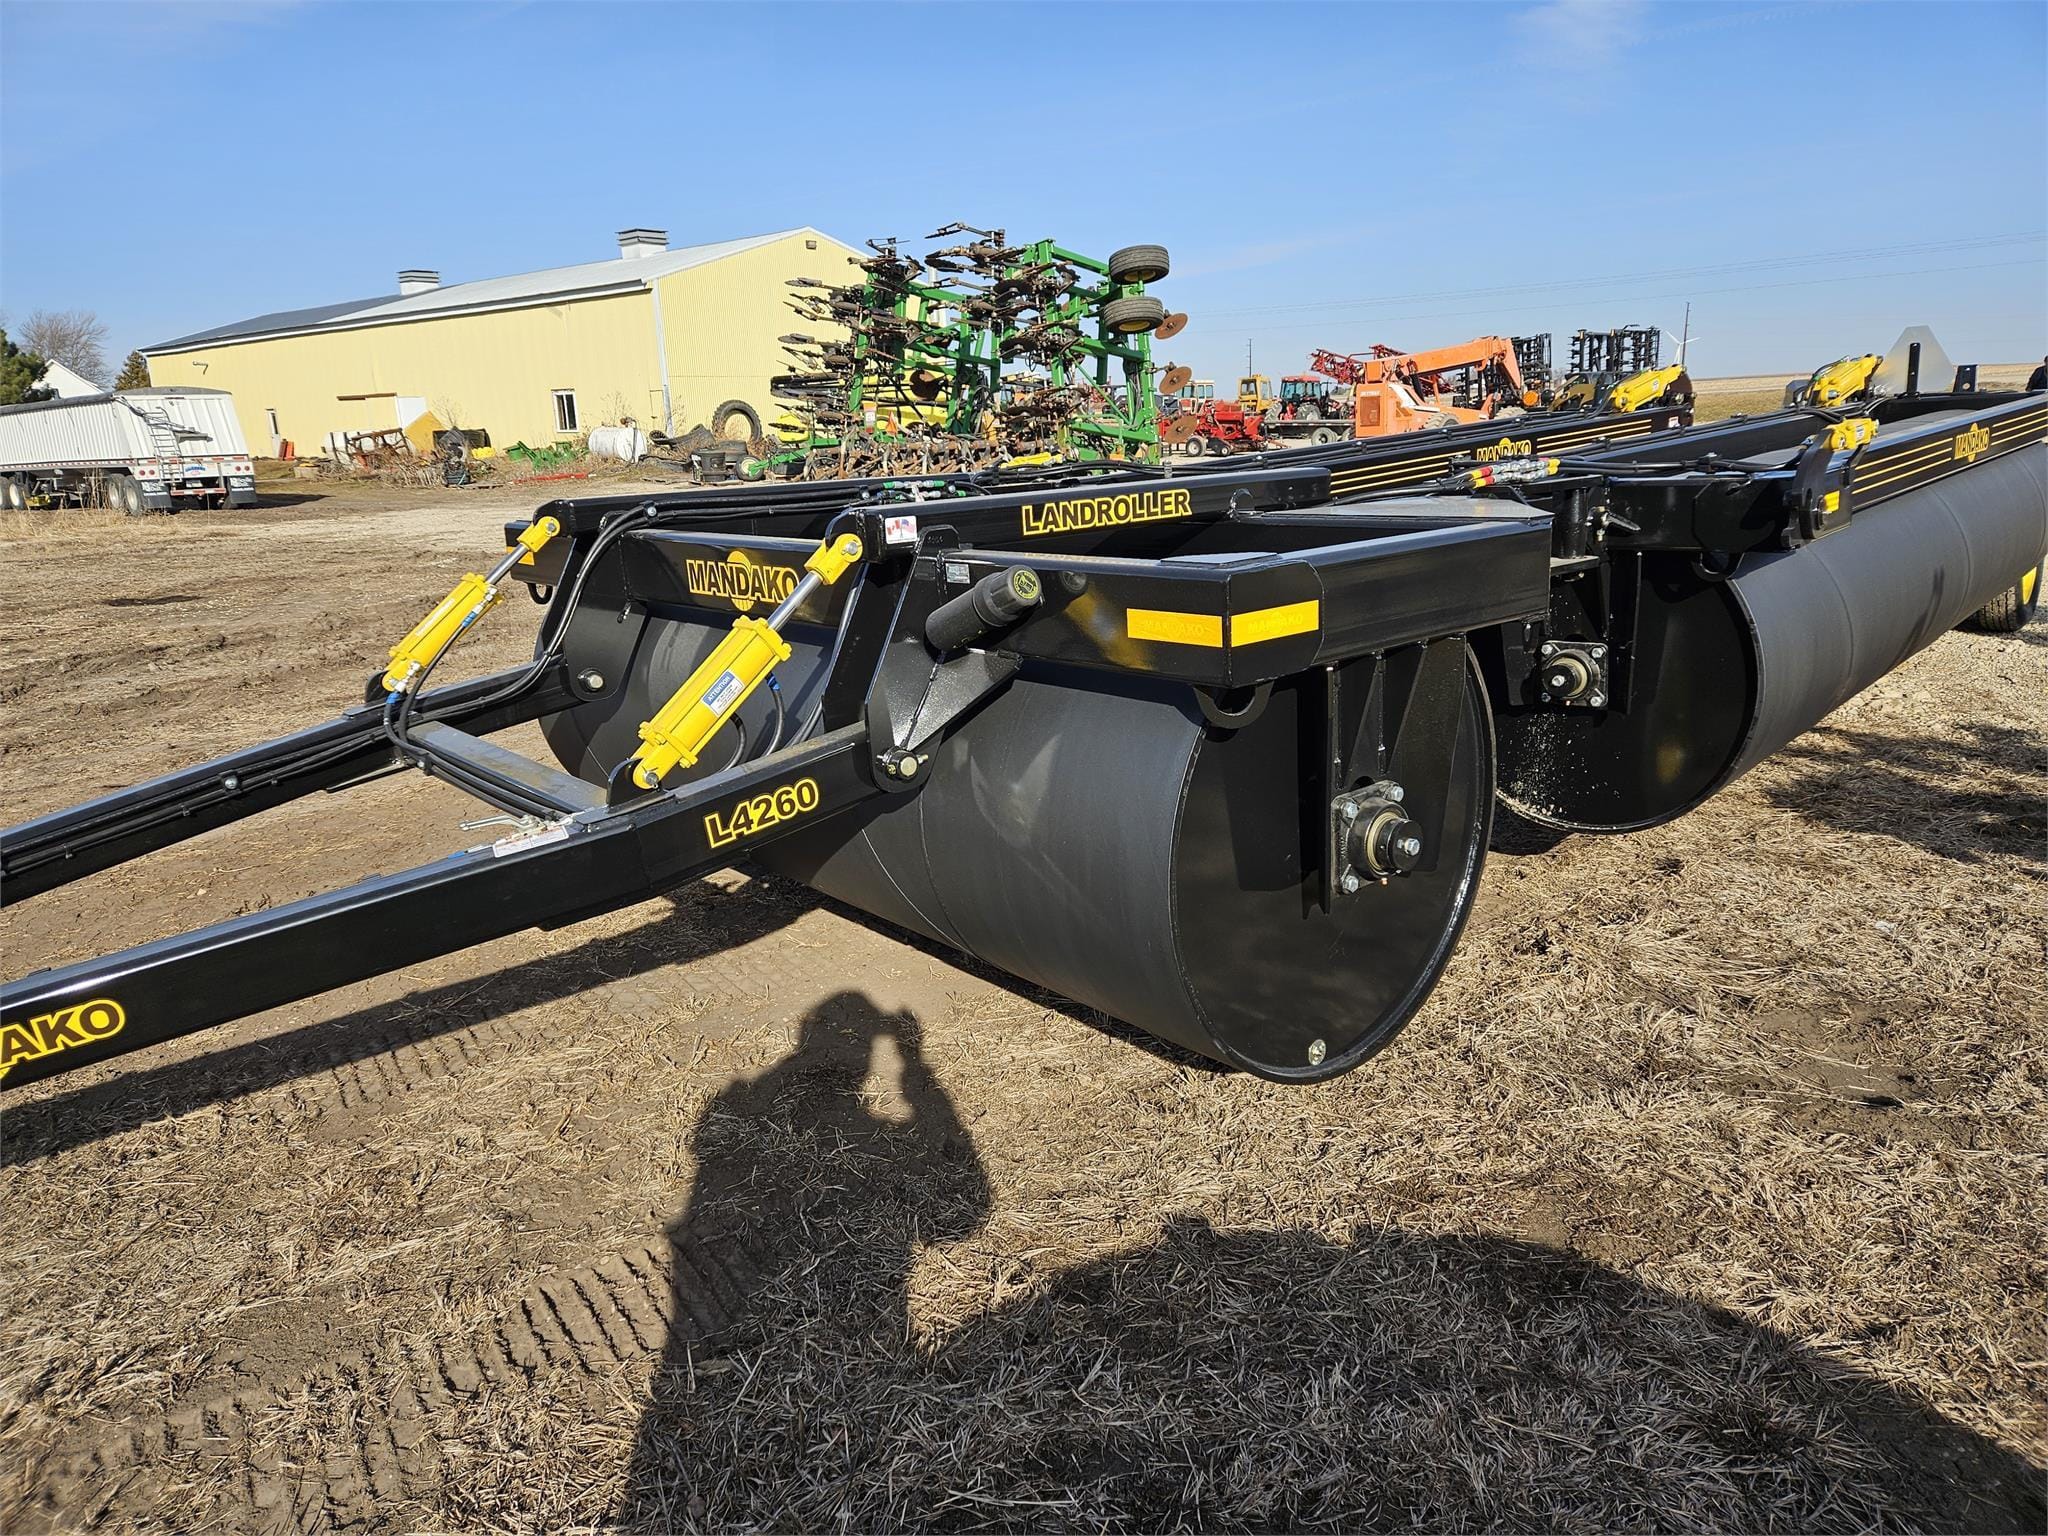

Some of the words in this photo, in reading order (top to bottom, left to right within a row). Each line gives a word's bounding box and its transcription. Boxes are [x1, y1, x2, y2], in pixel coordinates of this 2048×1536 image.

[1476, 439, 1532, 462] MANDAKO
[1954, 427, 1990, 460] MANDAKO
[1021, 488, 1193, 536] LANDROLLER
[686, 559, 800, 603] MANDAKO
[1247, 614, 1304, 634] MANAKO
[707, 675, 731, 703] ATTENTION
[703, 777, 820, 849] L4260
